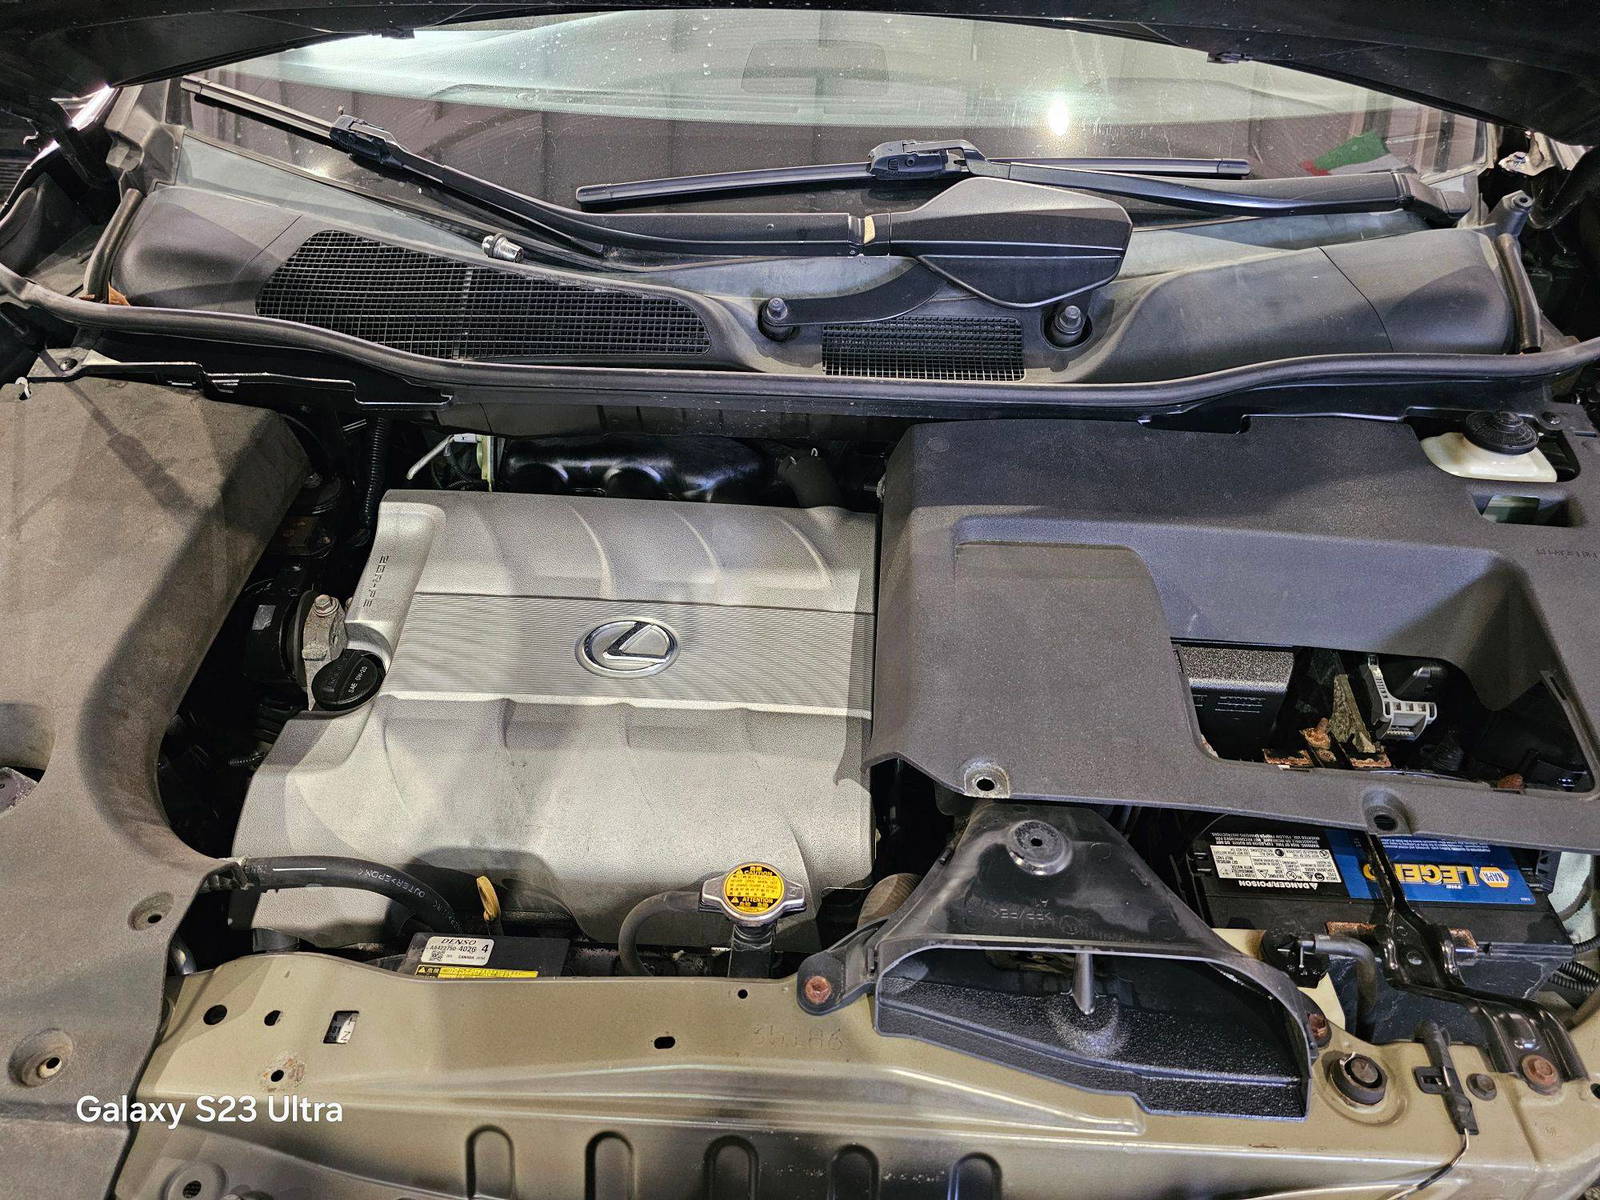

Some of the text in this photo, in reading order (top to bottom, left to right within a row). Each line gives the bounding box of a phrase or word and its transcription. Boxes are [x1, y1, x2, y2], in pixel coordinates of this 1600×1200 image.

[1362, 863, 1479, 886] LEGE
[1483, 871, 1505, 882] NAPA
[1239, 880, 1310, 889] DANGER/POISON
[481, 944, 489, 953] 4
